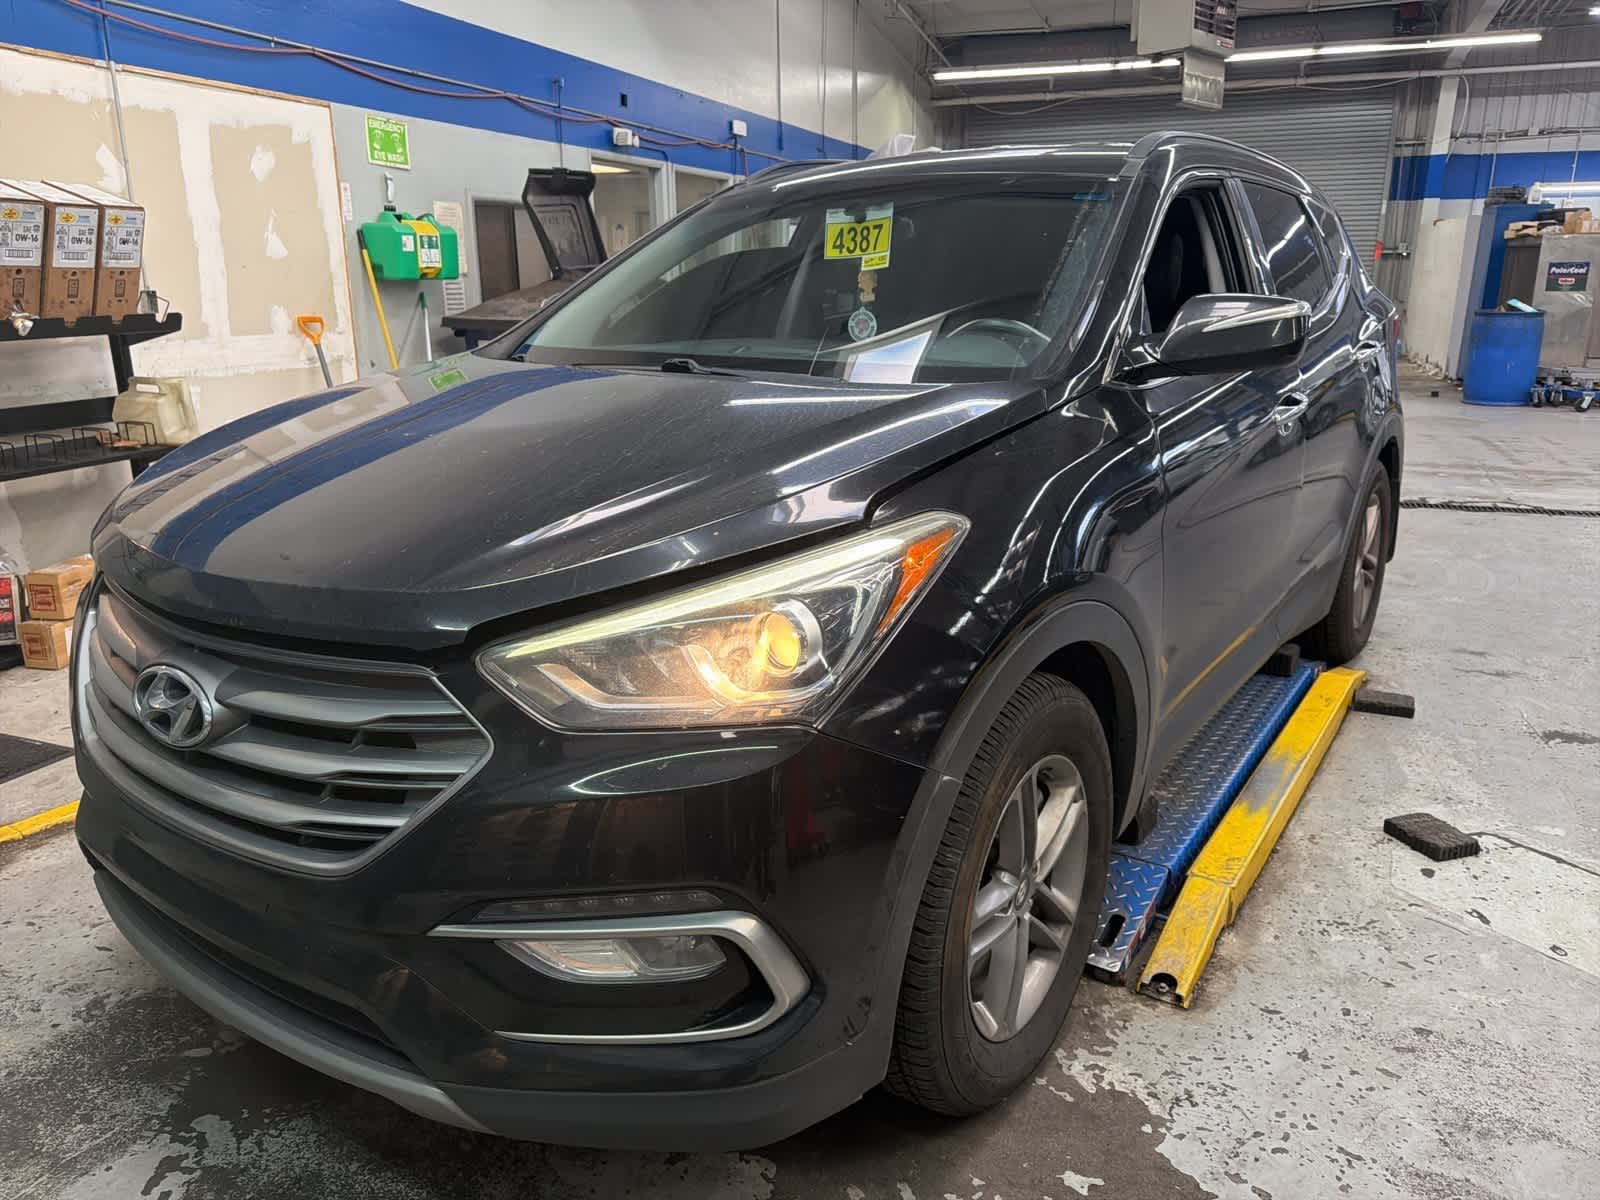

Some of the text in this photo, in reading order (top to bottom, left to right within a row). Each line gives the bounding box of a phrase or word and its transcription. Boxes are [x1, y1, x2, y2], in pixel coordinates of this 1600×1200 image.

[368, 118, 405, 134] EMERGENCY
[374, 150, 405, 163] EYE WASH
[831, 223, 884, 255] 4387
[1550, 266, 1588, 274] PolarCool
